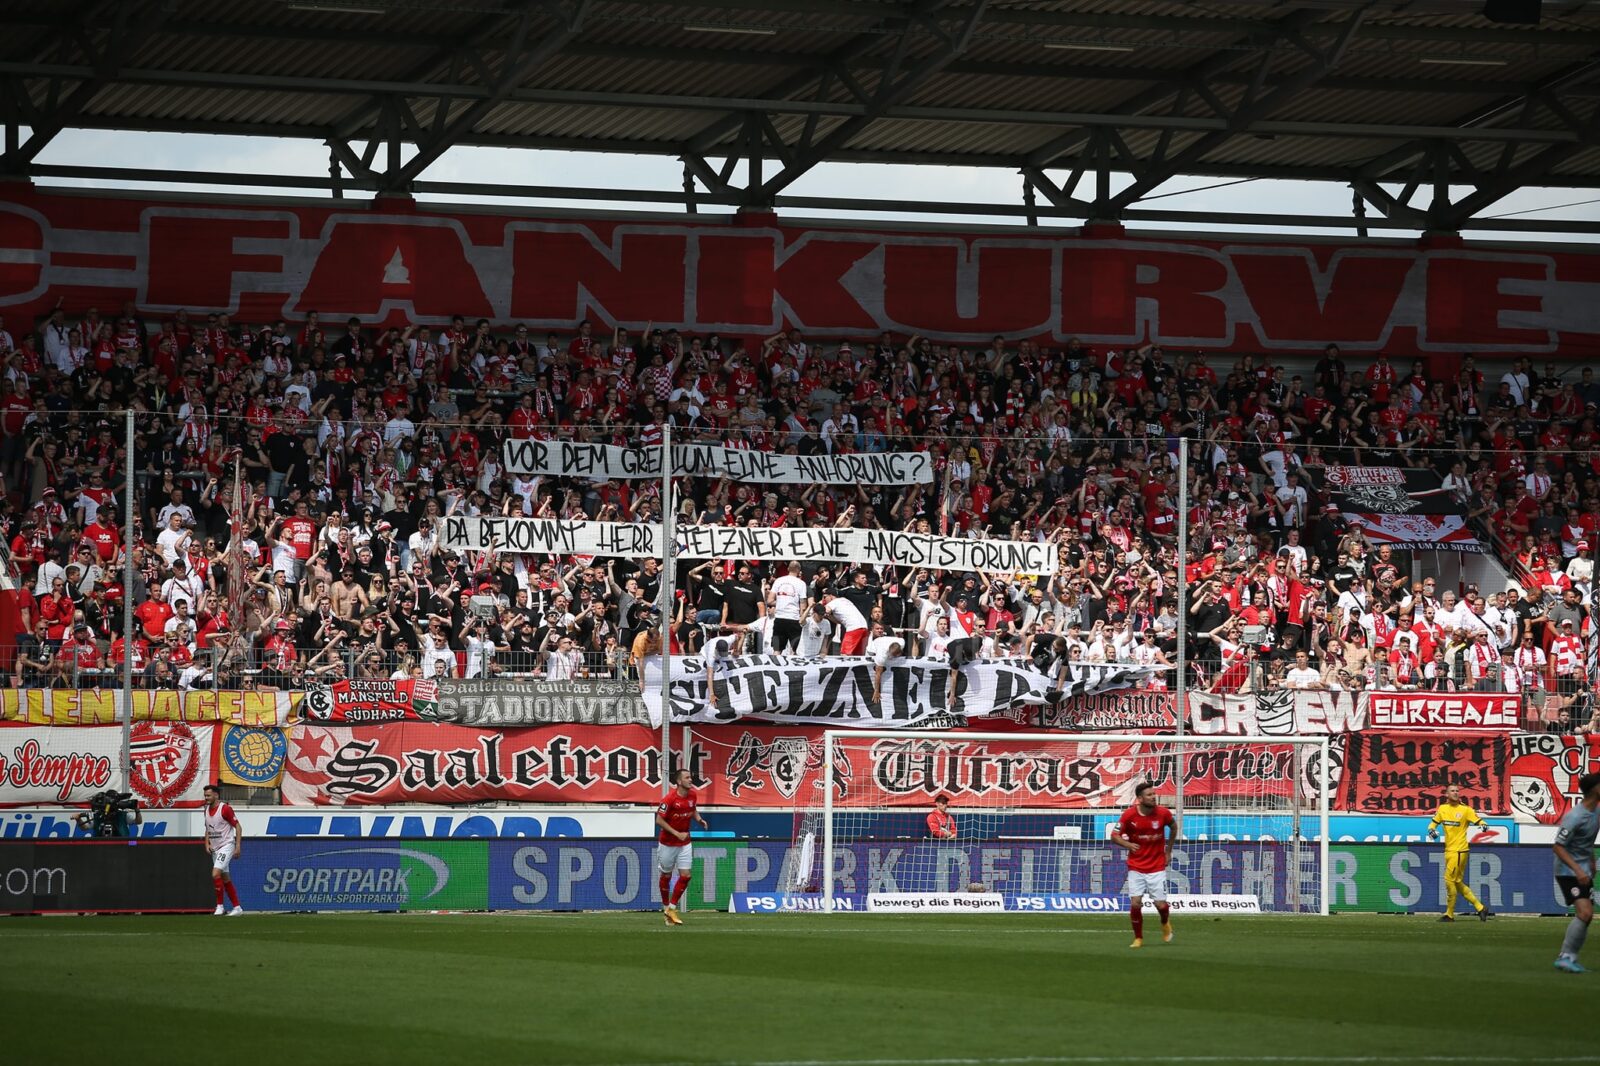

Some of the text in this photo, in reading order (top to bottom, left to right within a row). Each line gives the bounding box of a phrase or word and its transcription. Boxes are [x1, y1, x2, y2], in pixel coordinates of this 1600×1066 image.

[507, 440, 549, 471] VOR
[562, 443, 609, 474] DEM
[723, 450, 786, 480] EINE
[446, 517, 469, 546] DA
[480, 518, 587, 551] BEKOMMT
[596, 523, 654, 554] HERR
[676, 526, 784, 557] TELZNER
[789, 529, 854, 558] EINE
[350, 681, 396, 691] SEKTION
[338, 691, 408, 704] MANSFELD
[344, 707, 405, 722] SÜDHARZ
[1374, 699, 1518, 725] SURREALE
[1511, 736, 1556, 758] HFC
[10, 738, 111, 802] Sempre
[326, 732, 711, 795] Saalefront
[263, 867, 413, 894] SPORTPARK
[747, 897, 777, 910] PS
[873, 897, 1001, 911] bewegt die Region
[1017, 897, 1120, 911] PS UNION
[1211, 898, 1256, 911] Region
